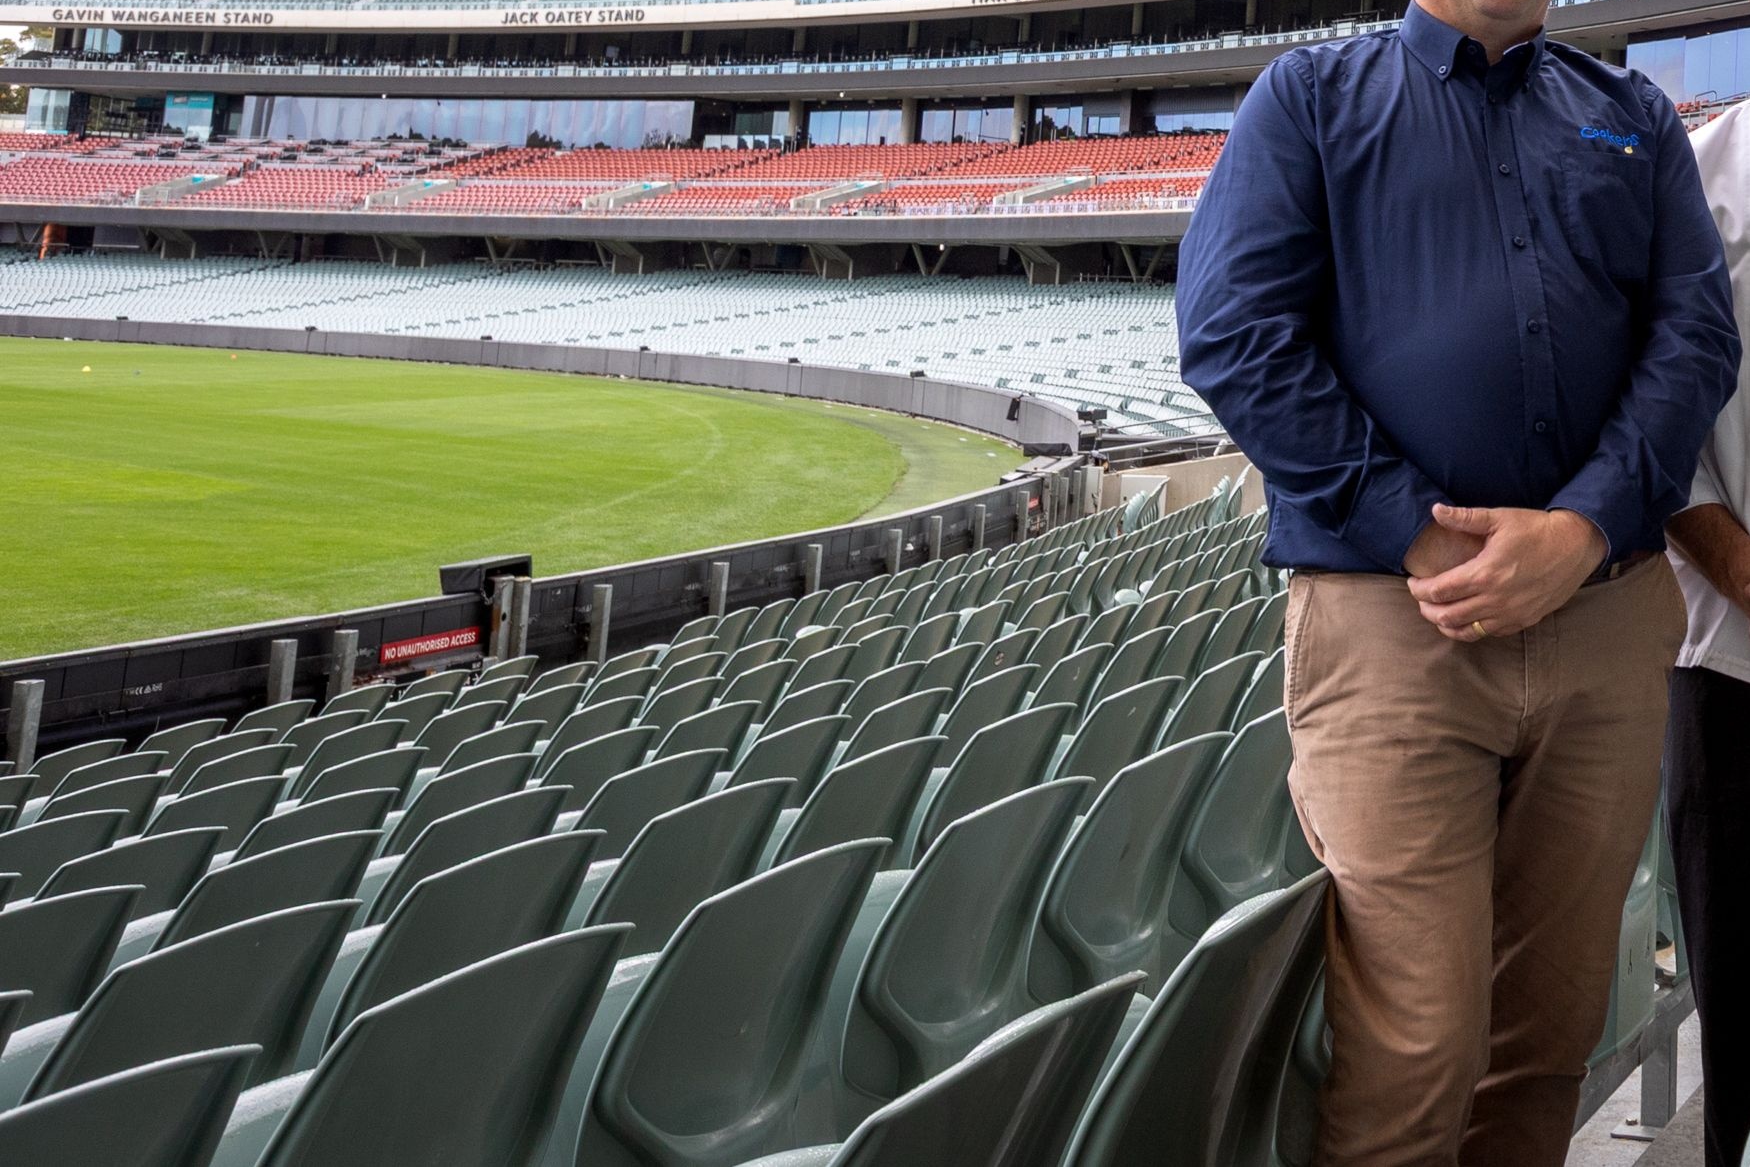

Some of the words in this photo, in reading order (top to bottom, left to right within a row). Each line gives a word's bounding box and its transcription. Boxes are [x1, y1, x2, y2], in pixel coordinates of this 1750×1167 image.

[52, 9, 104, 22] GAVIN
[112, 10, 216, 24] WANGANEEN
[224, 12, 274, 25] STAND
[501, 11, 538, 24] JACK
[545, 10, 592, 24] OATEY
[598, 9, 645, 22] STAND
[1580, 126, 1640, 147] Cookers
[384, 644, 396, 660] NO
[397, 636, 450, 657] UNAUTHORISED
[451, 632, 476, 647] ACCESS
